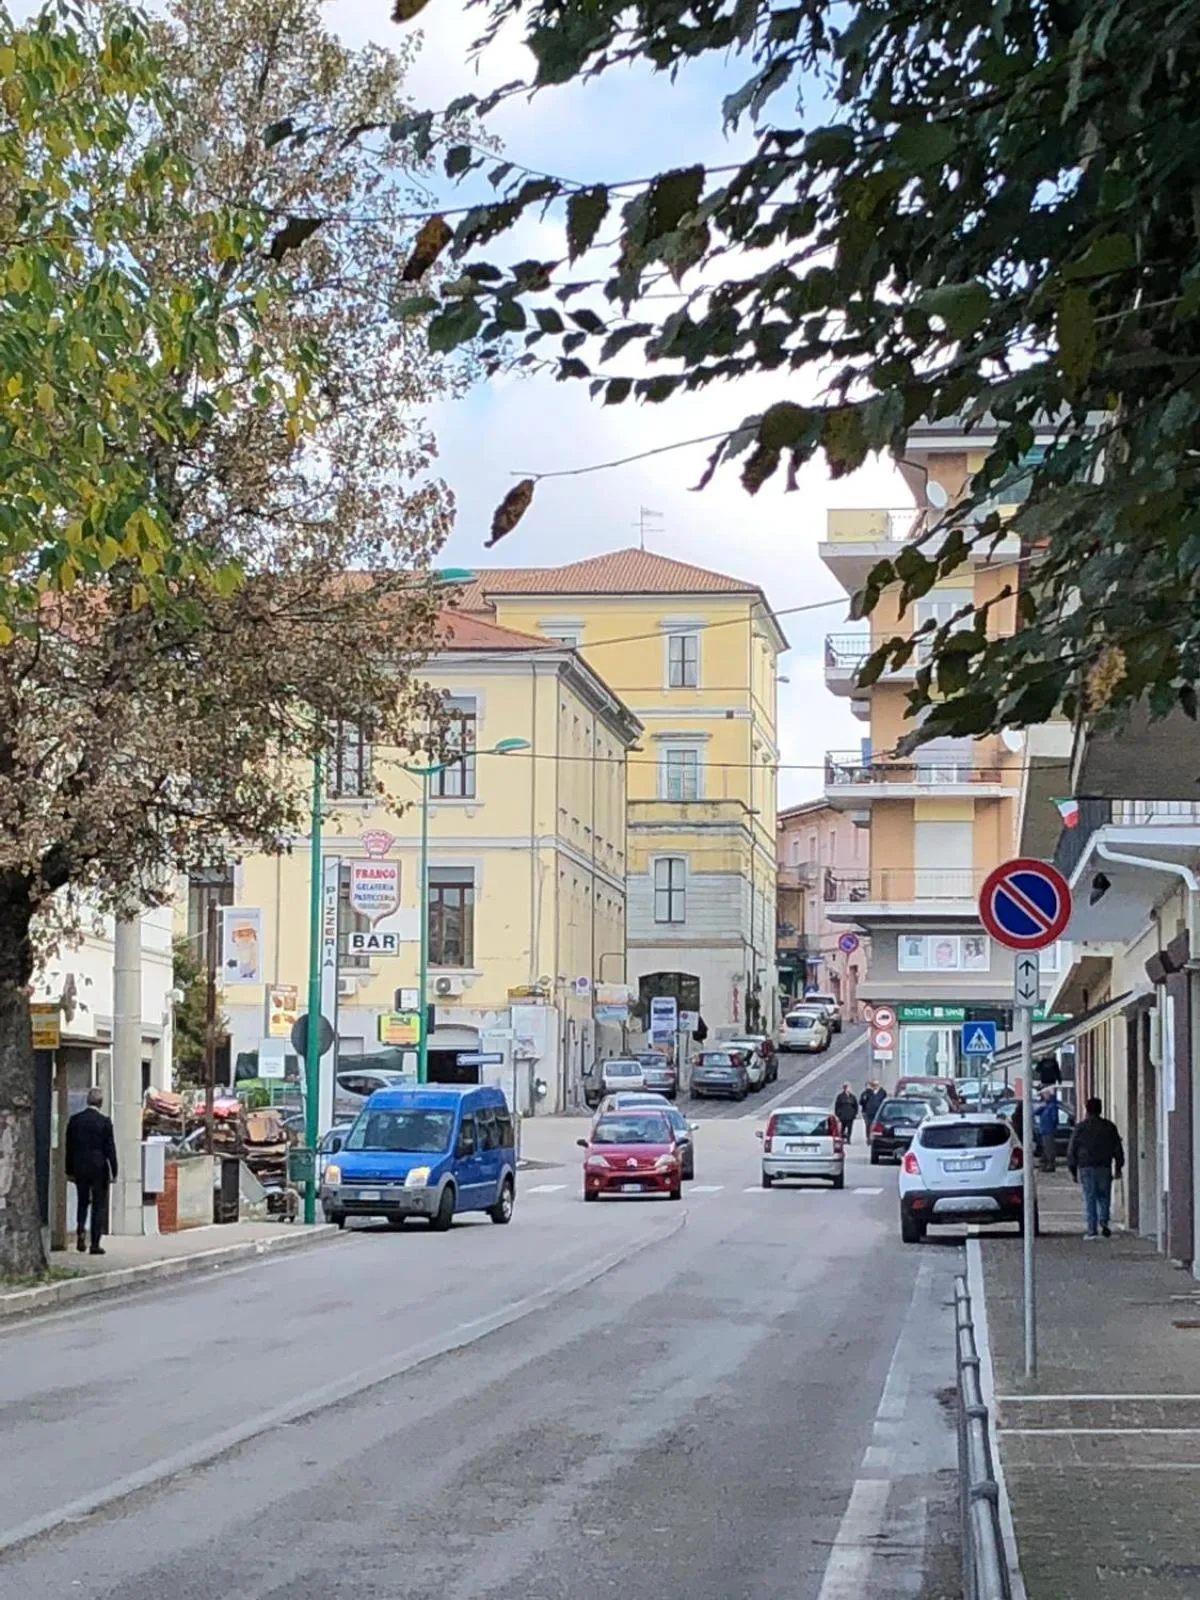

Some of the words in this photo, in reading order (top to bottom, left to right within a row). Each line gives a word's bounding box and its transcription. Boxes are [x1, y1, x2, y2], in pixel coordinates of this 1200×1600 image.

[355, 868, 396, 879] FRANCO
[356, 883, 394, 891] GELATERIA
[354, 893, 396, 901] PASTICCERIA
[323, 886, 336, 967] PIZZERIA
[353, 935, 395, 948] BAR
